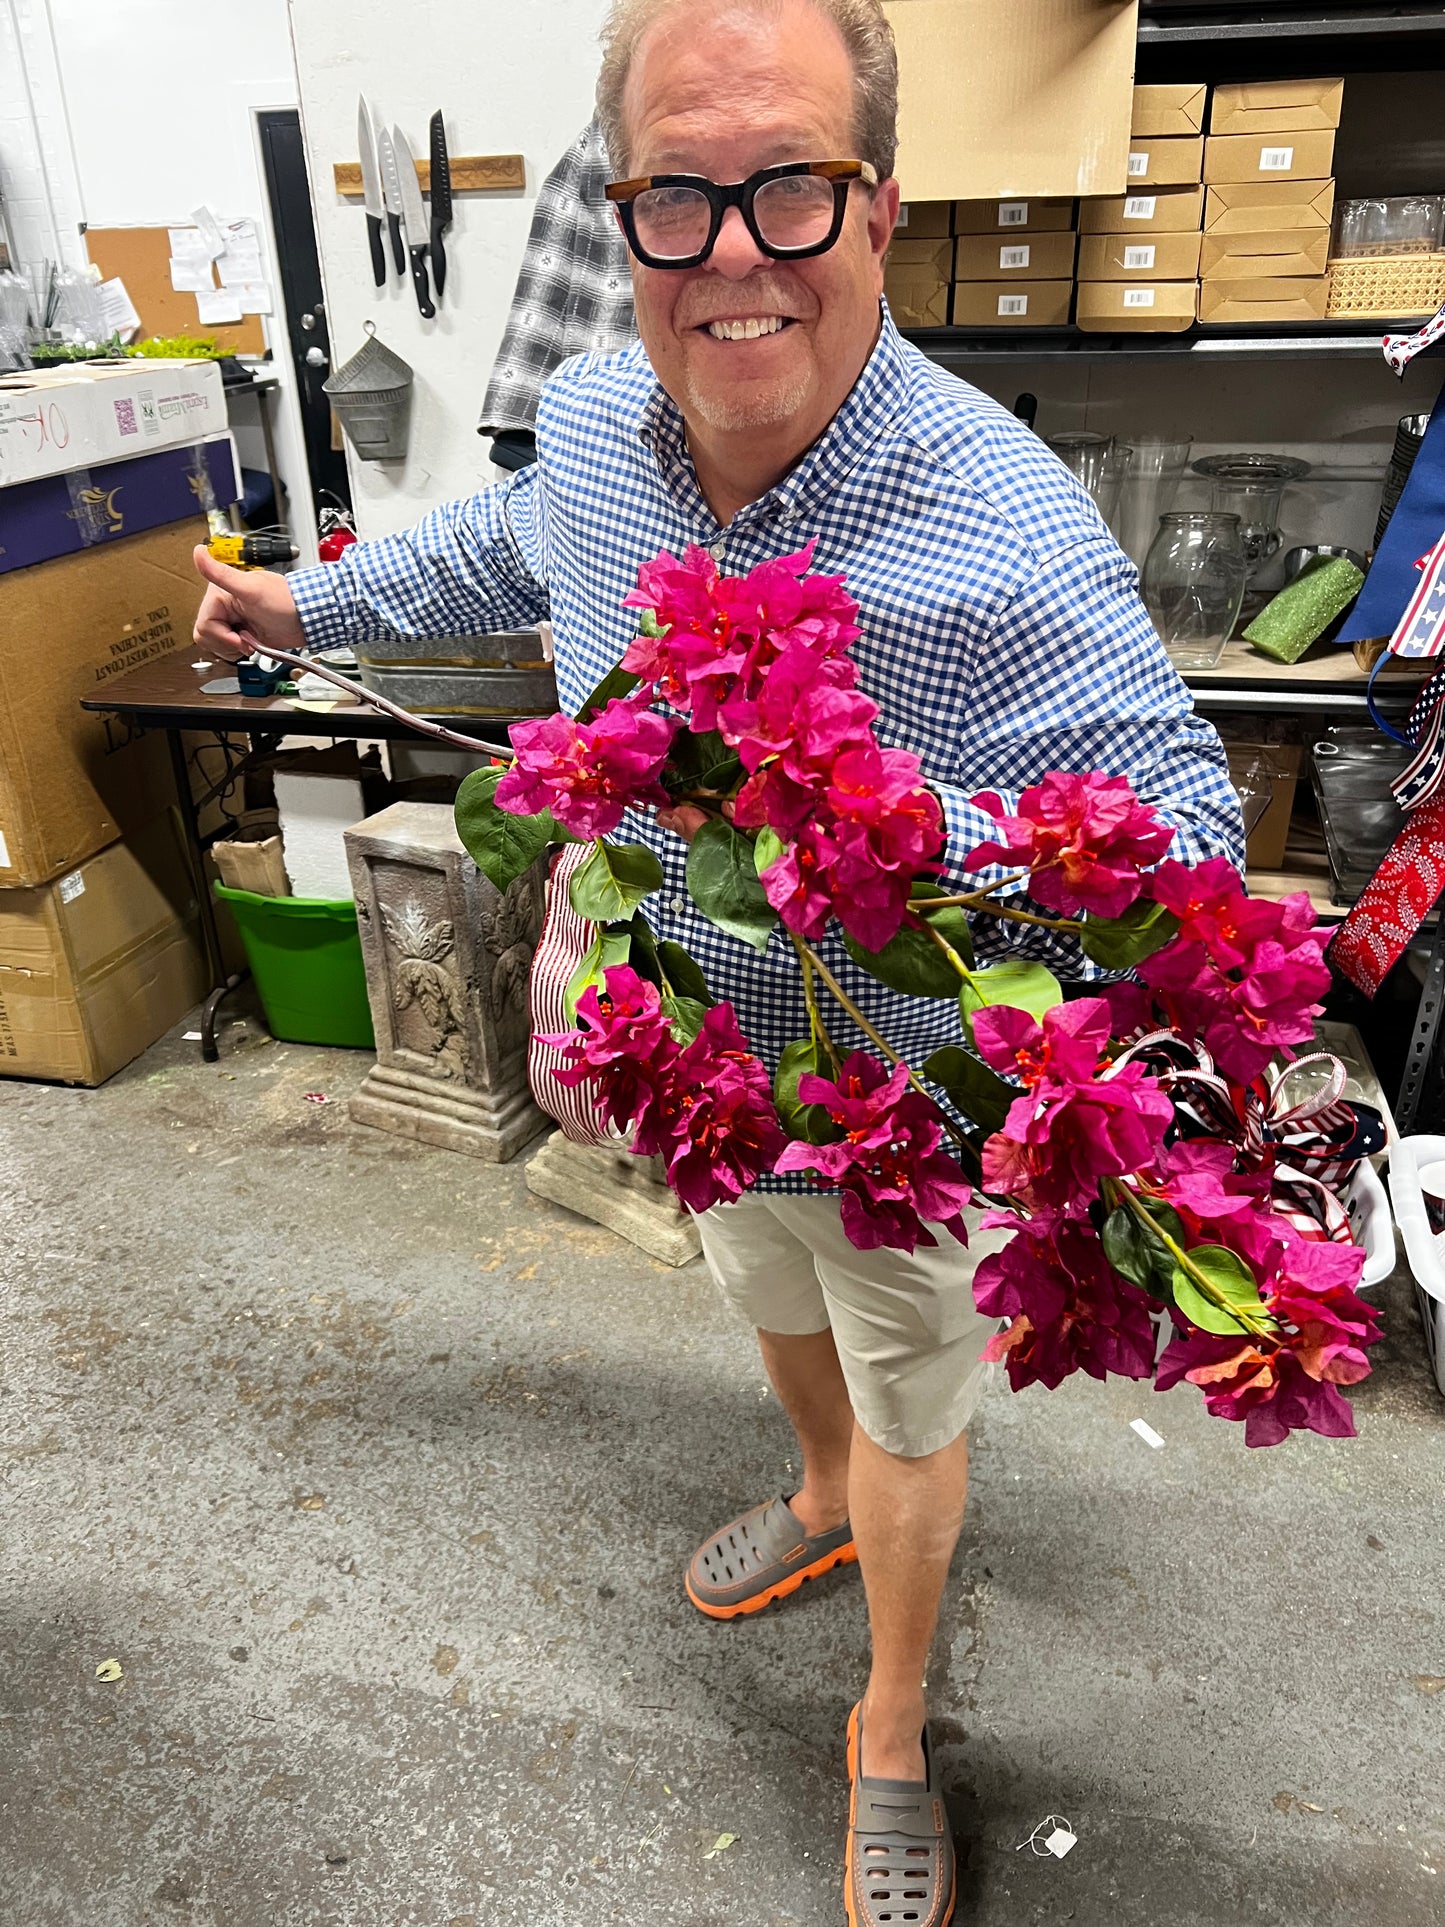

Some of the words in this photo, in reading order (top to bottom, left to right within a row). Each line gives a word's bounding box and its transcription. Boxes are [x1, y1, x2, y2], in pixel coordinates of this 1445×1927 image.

[138, 631, 149, 643] IN
[148, 622, 173, 640] MADE
[109, 635, 138, 656] CHINA
[127, 648, 149, 667] WEST
[95, 658, 125, 681] COAST
